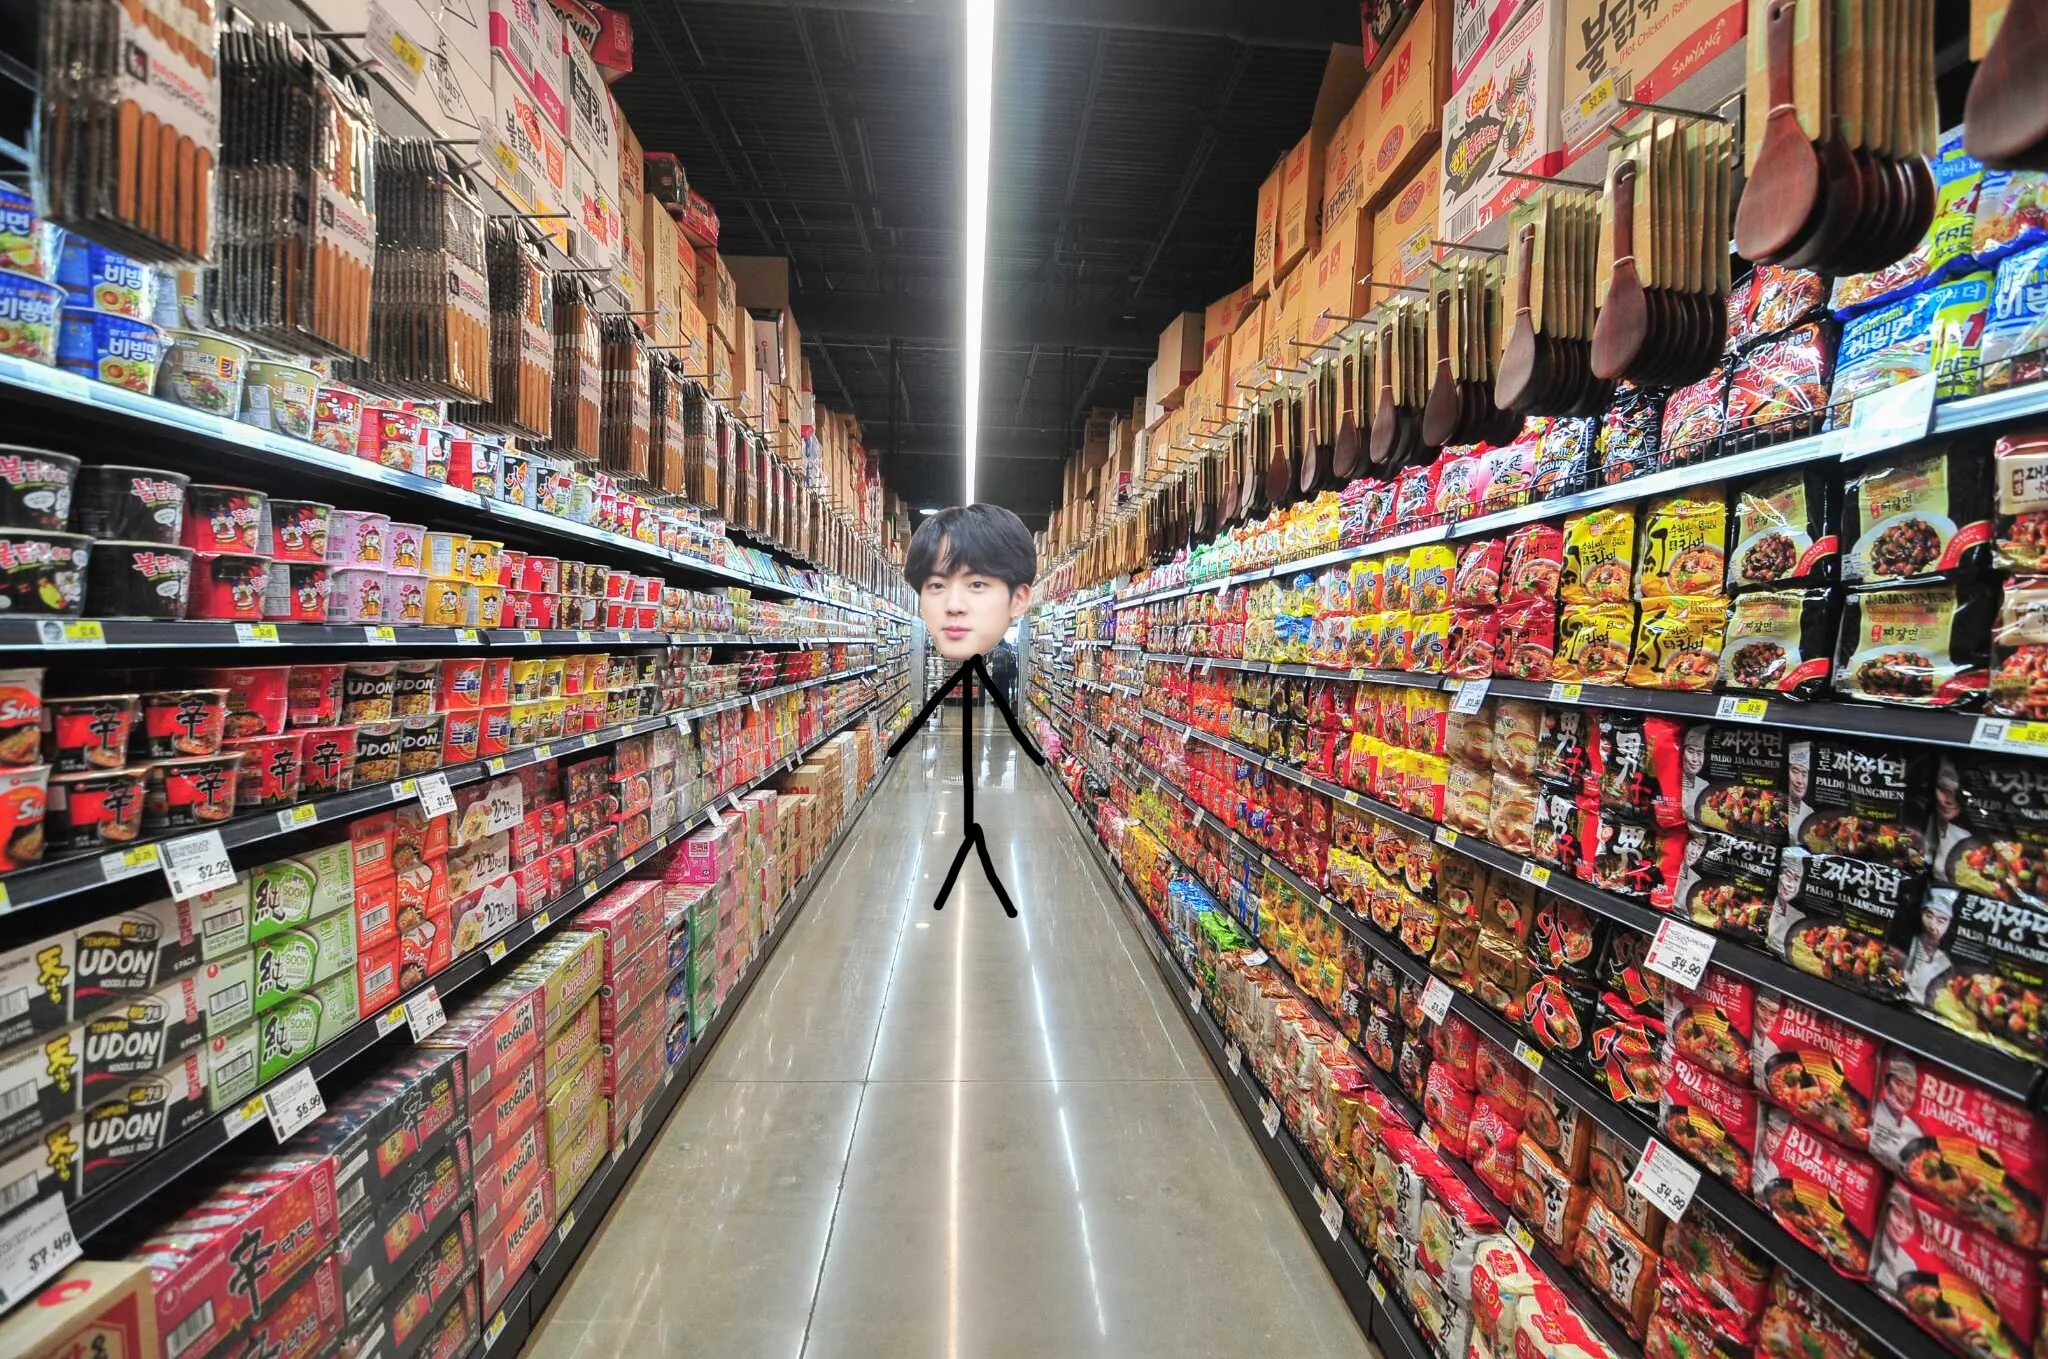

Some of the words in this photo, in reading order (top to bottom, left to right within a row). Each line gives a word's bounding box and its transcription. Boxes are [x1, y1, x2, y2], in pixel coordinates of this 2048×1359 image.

[1637, 14, 1671, 47] Chicken
[1672, 31, 1722, 78] SAMYANG
[1936, 223, 1973, 246] FRE
[1883, 626, 1919, 641] 짜장면
[348, 679, 394, 696] UDON
[403, 731, 438, 749] DON
[1710, 753, 1732, 764] PALDO
[1721, 729, 1784, 758] 짜장면
[311, 740, 345, 780] 辛
[1832, 750, 1908, 788] 짜장면
[195, 762, 227, 807] 辛
[1815, 776, 1845, 790] PALDO
[198, 859, 231, 878] $2.29
[1822, 859, 1900, 907] 짜장면
[1805, 883, 1835, 899] PALDO
[78, 948, 154, 977] UDON
[285, 952, 309, 967] SOON
[289, 1017, 313, 1031] SOON
[496, 1015, 533, 1052] NEOGURI
[1780, 1020, 1845, 1058] JJAMPPONG
[86, 1031, 162, 1063] UDON
[496, 1077, 534, 1120] NEOGURI
[1920, 1072, 1968, 1116] BUL
[87, 1110, 162, 1149] UDON
[1919, 1099, 2000, 1148] JJAMPPONG
[1786, 1125, 1825, 1165] BUL
[502, 1142, 536, 1190] NEOGURI
[1781, 1145, 1843, 1195] JJAMPPONG
[280, 1216, 314, 1253] 라면
[507, 1200, 543, 1254] NEOGURI
[1917, 1207, 1968, 1257] BUL
[228, 1226, 278, 1321] 辛
